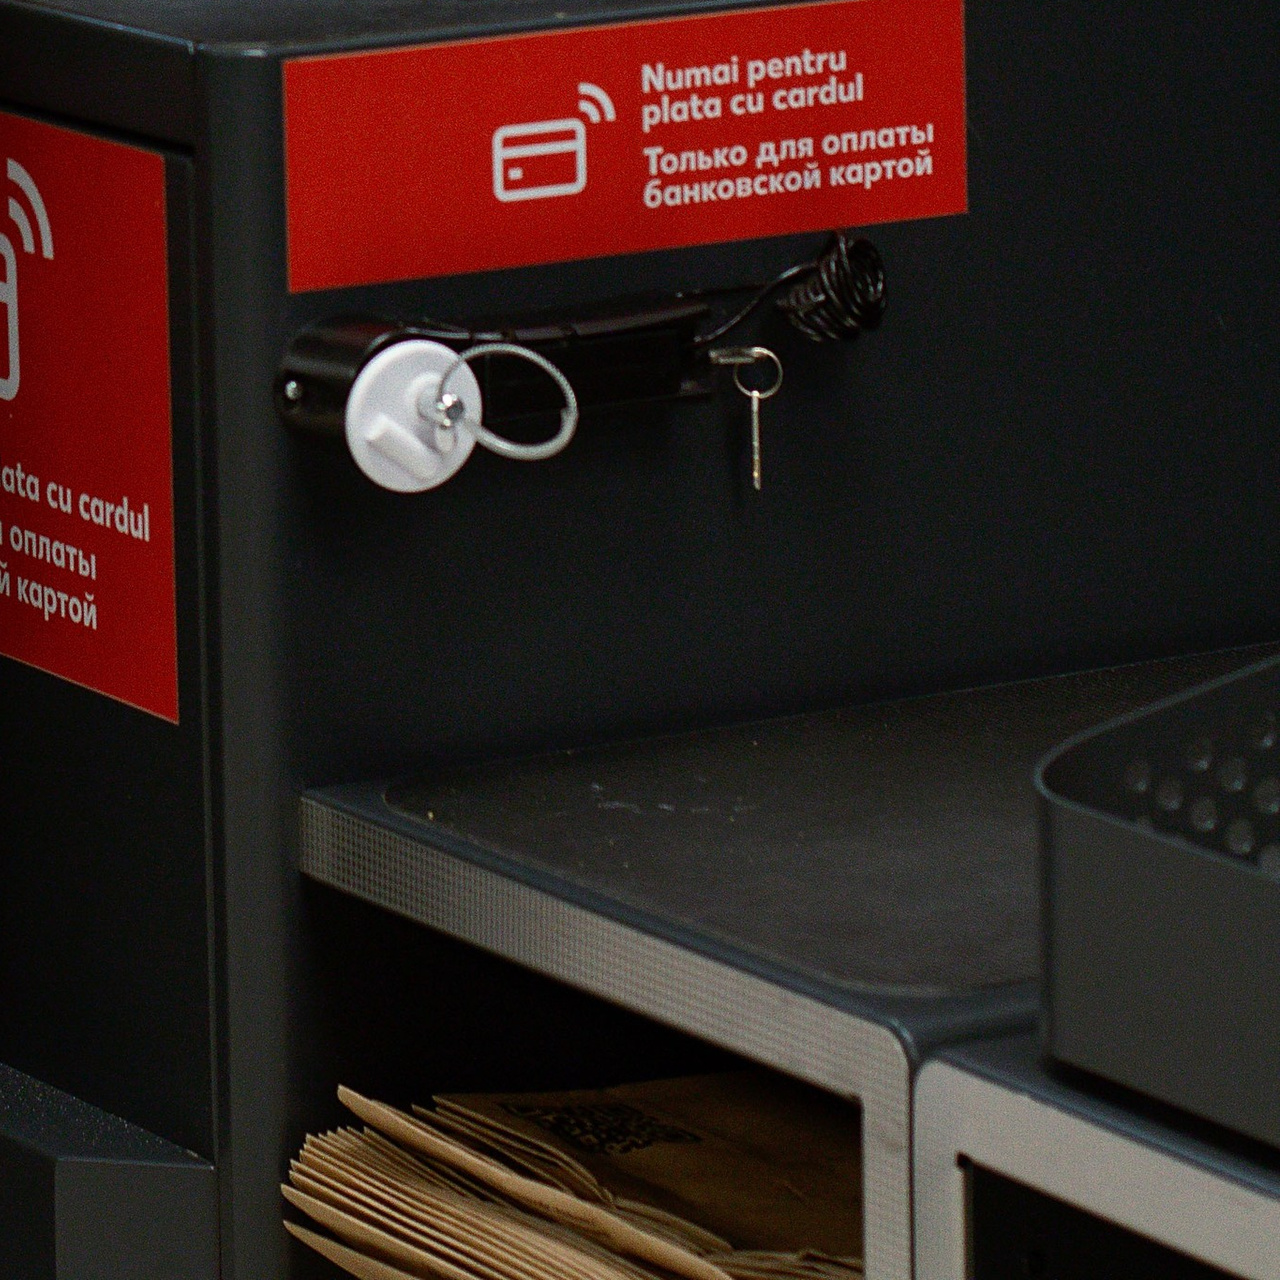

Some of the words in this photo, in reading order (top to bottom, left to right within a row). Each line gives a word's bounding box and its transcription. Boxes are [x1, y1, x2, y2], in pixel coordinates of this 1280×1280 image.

[641, 55, 739, 95] Numai
[746, 48, 848, 86] pentru
[641, 94, 722, 134] plata
[729, 93, 764, 115] cu
[772, 73, 864, 111] cardul
[643, 144, 748, 177] Только
[754, 137, 815, 168] для
[821, 121, 935, 158] оплаты
[643, 163, 822, 209] банковской
[828, 148, 934, 191] картой
[46, 481, 72, 515] cu
[78, 493, 150, 543] cardul
[9, 524, 97, 581] оплаты
[16, 575, 98, 631] картой
